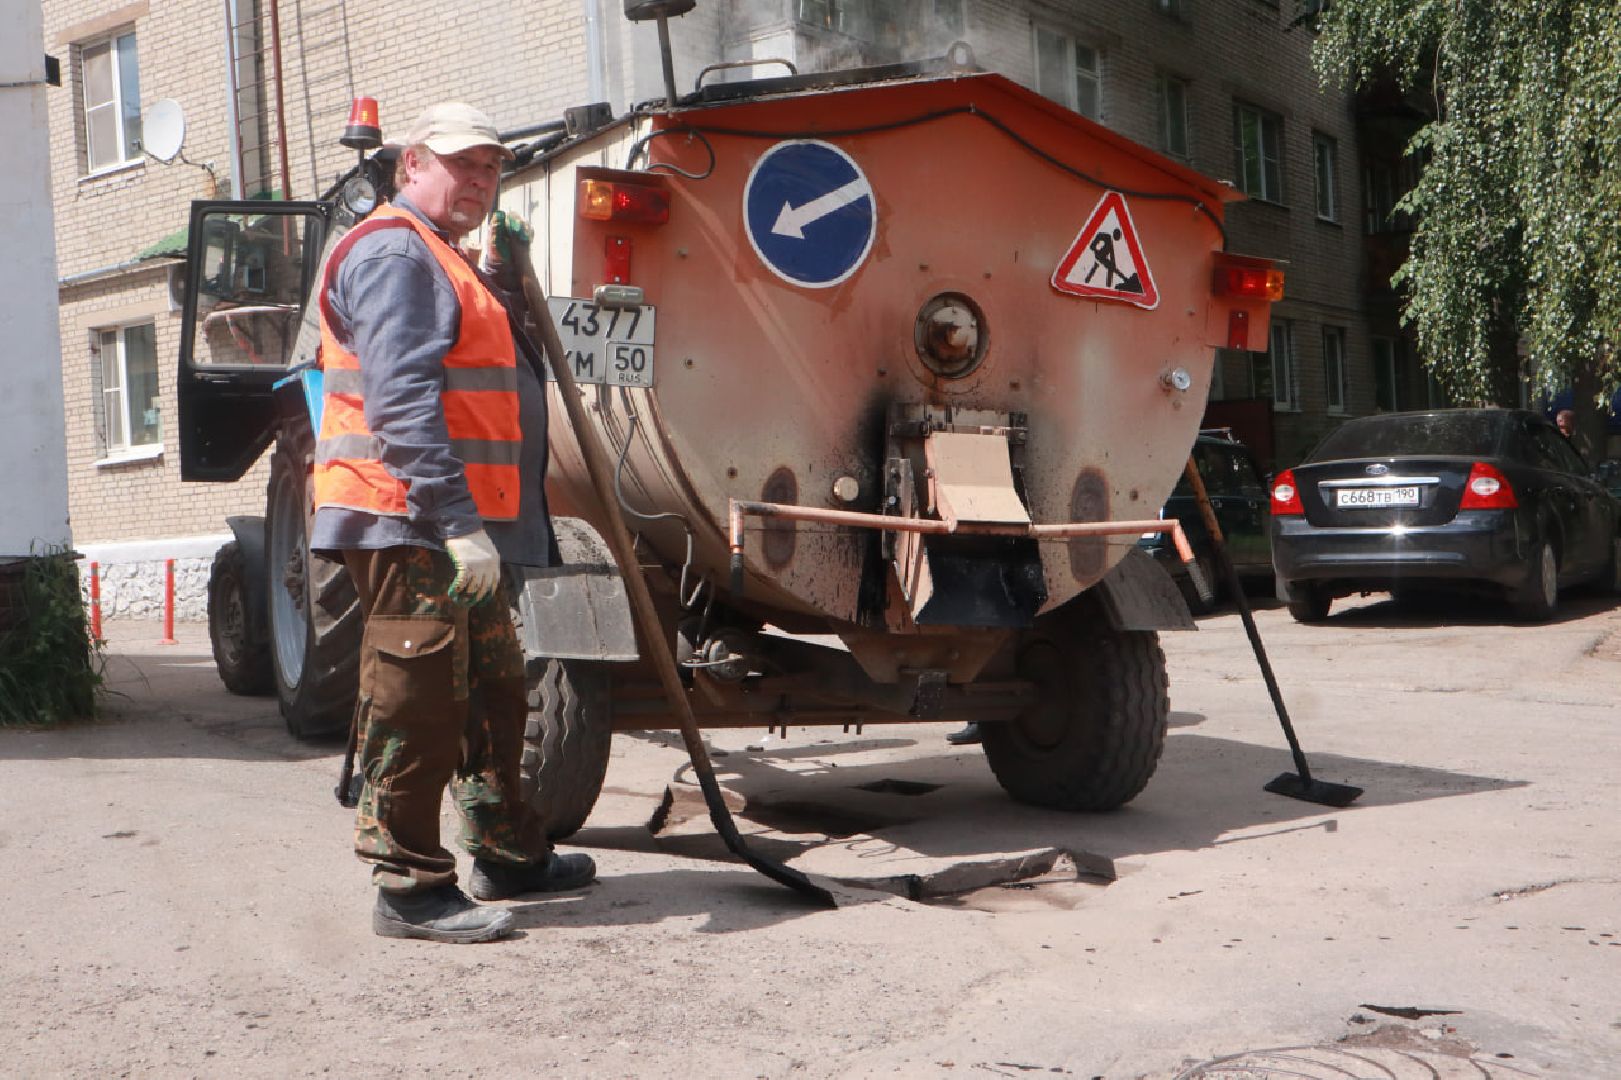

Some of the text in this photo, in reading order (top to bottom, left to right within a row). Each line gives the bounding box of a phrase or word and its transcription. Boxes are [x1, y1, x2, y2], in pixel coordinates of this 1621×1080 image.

[562, 302, 642, 340] 4377
[564, 350, 594, 378] М
[615, 346, 646, 372] 50
[618, 372, 641, 383] RUS
